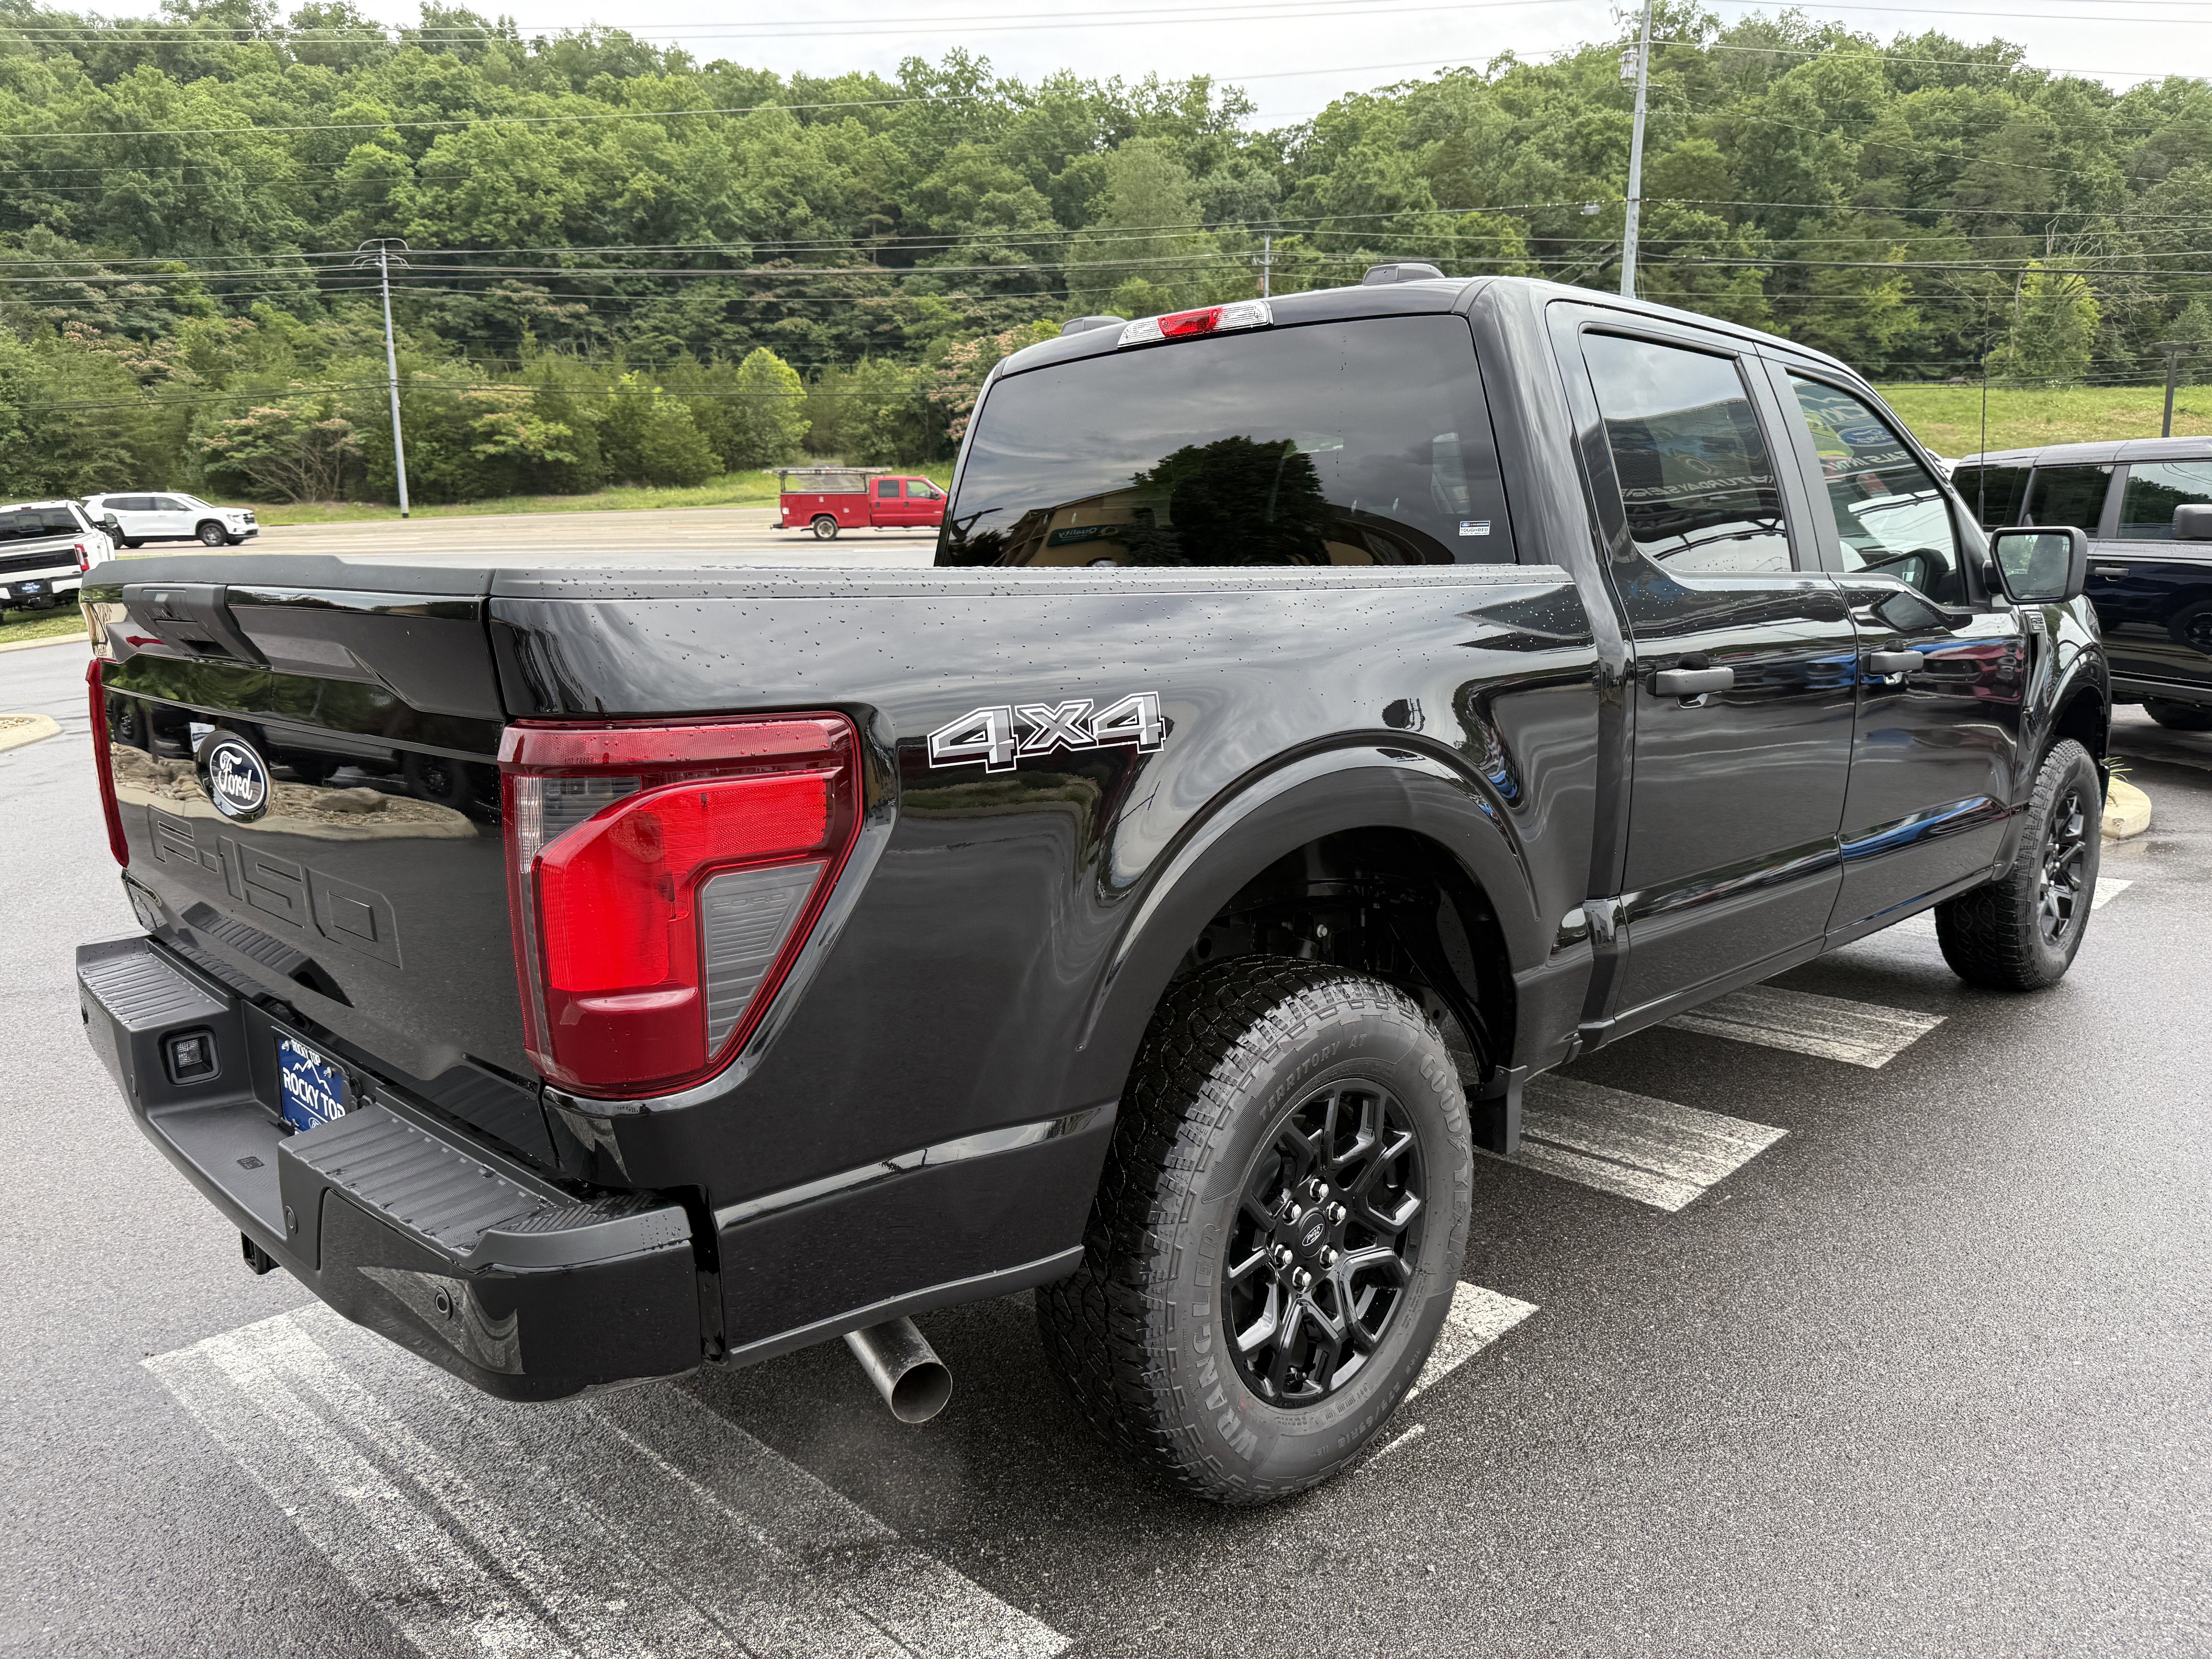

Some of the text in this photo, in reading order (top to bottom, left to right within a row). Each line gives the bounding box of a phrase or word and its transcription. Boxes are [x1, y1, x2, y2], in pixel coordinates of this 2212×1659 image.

[218, 750, 253, 800] Ford
[710, 893, 787, 911] FORD
[291, 1039, 321, 1066] ROCKY TOP
[283, 1067, 319, 1109] ROCKY
[1259, 1034, 1367, 1121] TERRITORY AT
[1419, 1053, 1469, 1274] GOODYEAR
[1306, 1226, 1320, 1243] Ford
[1192, 1223, 1258, 1462] WRANGLER
